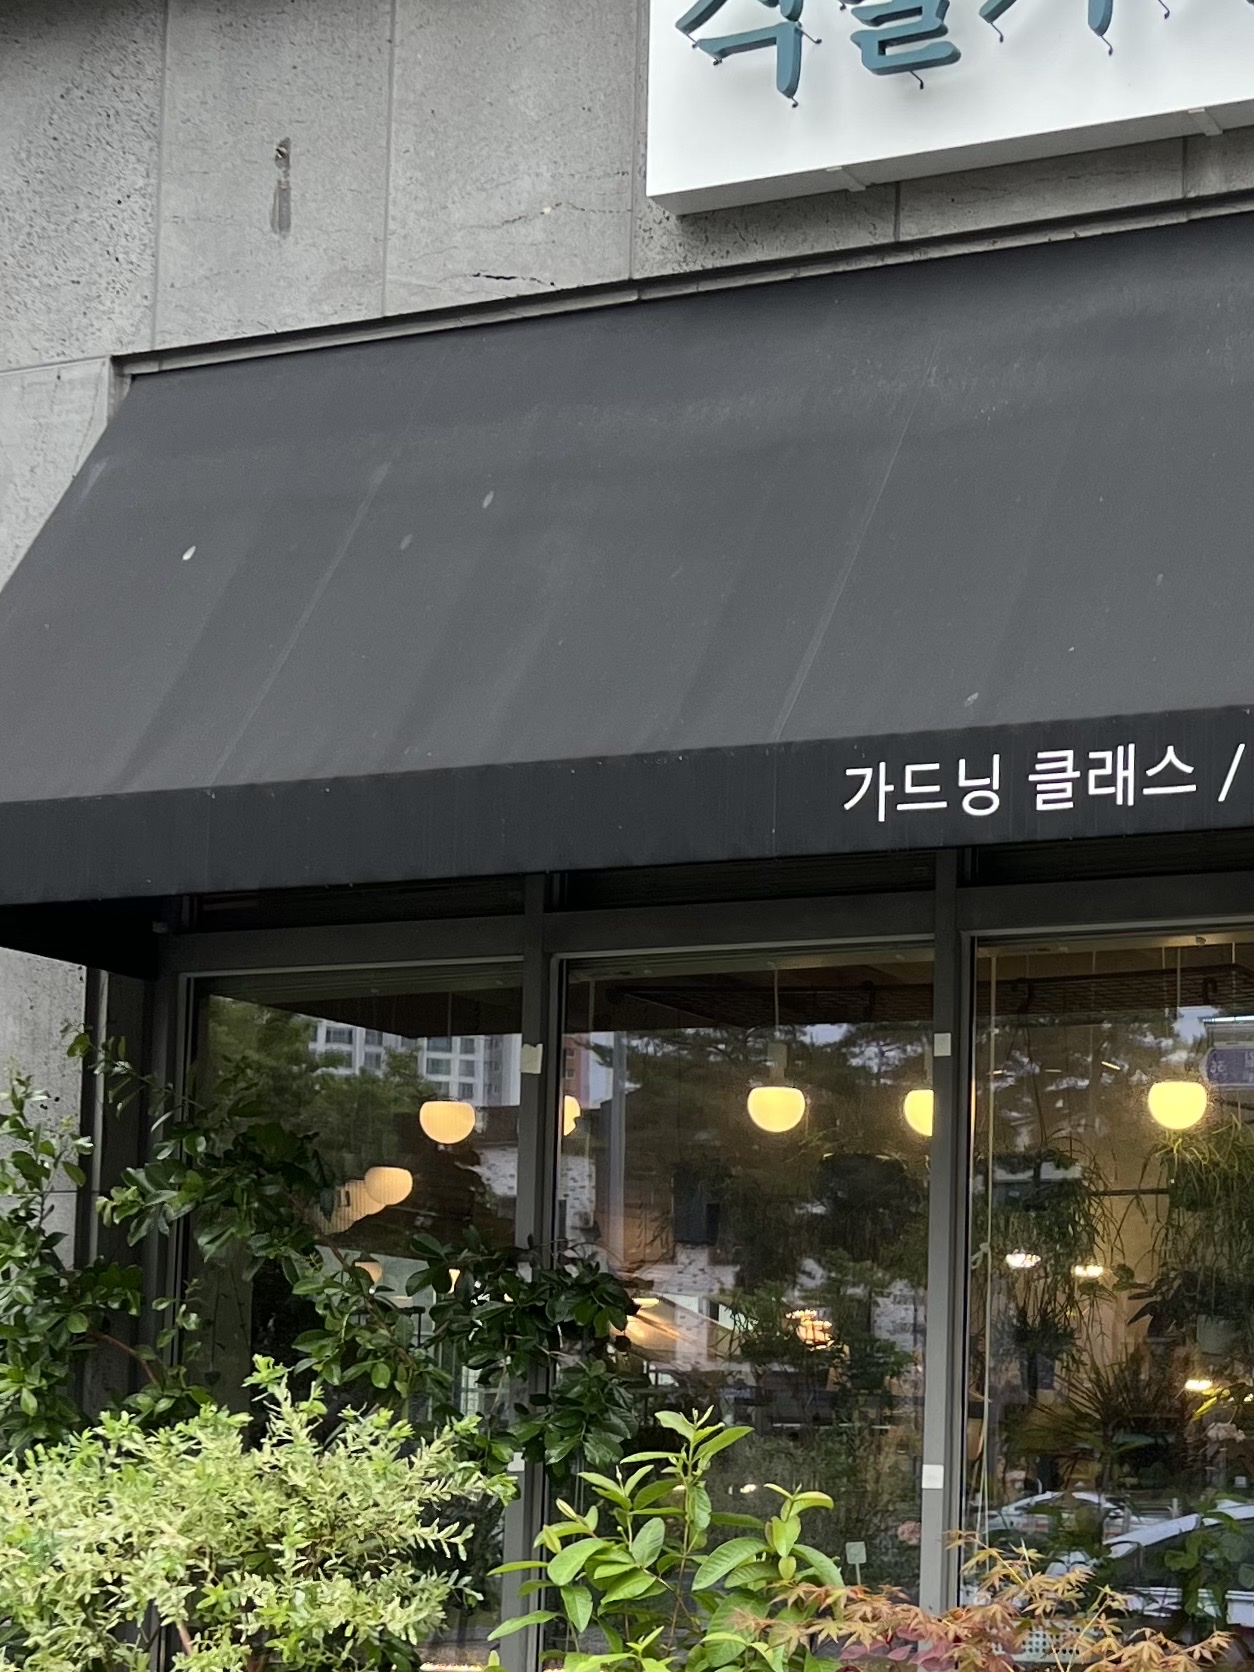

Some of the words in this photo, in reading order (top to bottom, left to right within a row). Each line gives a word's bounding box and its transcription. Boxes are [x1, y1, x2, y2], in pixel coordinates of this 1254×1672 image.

[844, 754, 999, 821] 가드닝
[1029, 744, 1196, 810] 클래스
[1219, 744, 1245, 801] /
